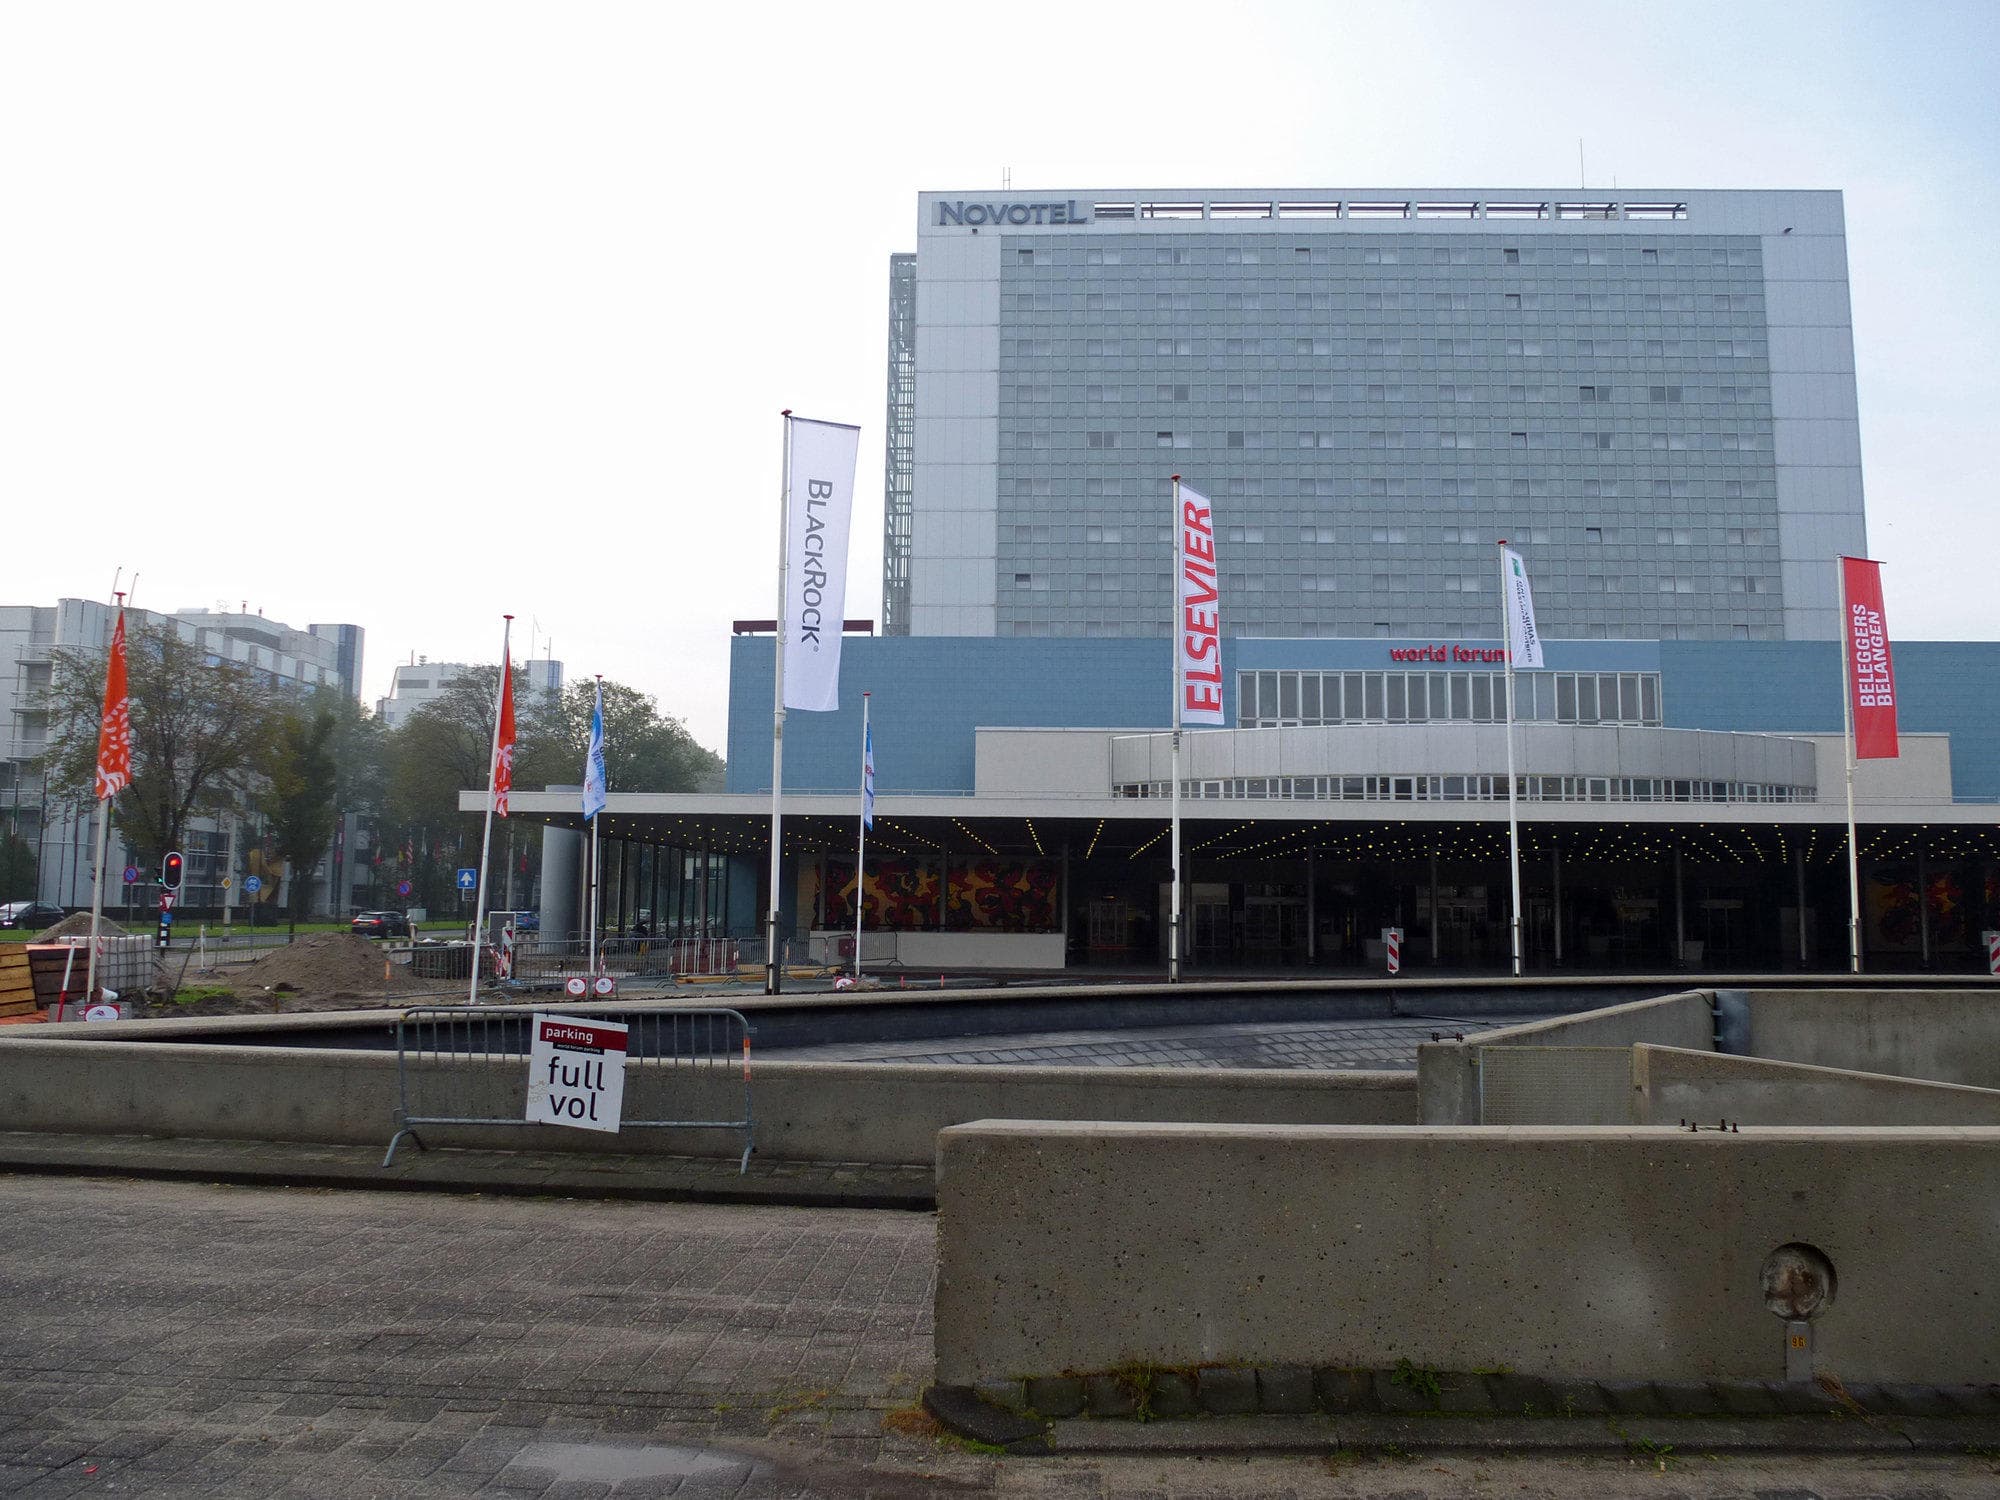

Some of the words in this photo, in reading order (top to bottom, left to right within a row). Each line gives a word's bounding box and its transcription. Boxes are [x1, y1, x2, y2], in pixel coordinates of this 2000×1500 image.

[939, 200, 1087, 225] NOVOTEL
[1184, 501, 1222, 711] ELSEVIER
[1390, 644, 1447, 662] world
[1852, 604, 1876, 707] BELEGGERS
[1868, 611, 1893, 707] BELANGEN
[545, 1027, 594, 1044] parking
[548, 1056, 605, 1092] full
[549, 1092, 598, 1121] vol
